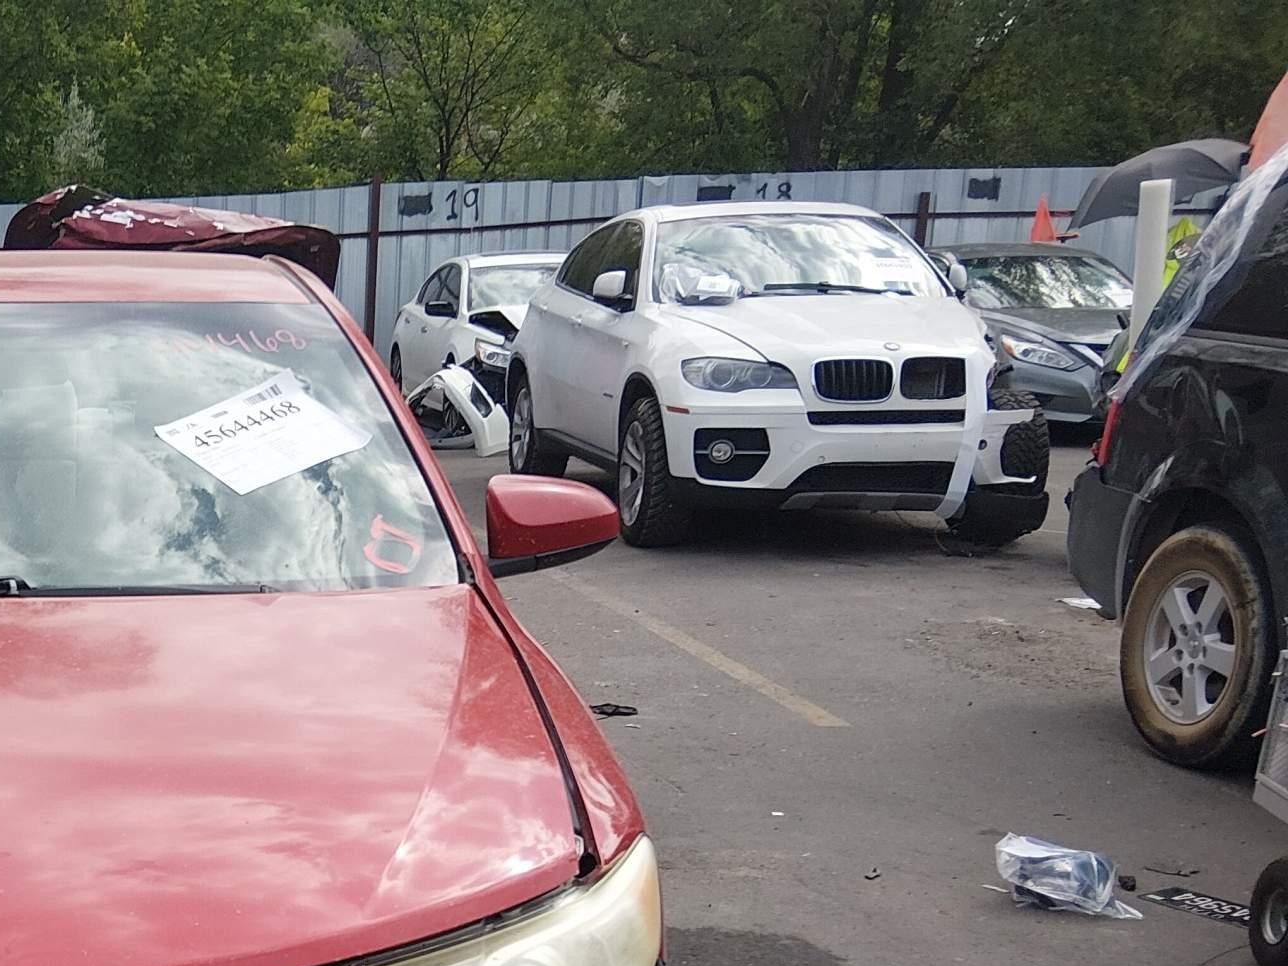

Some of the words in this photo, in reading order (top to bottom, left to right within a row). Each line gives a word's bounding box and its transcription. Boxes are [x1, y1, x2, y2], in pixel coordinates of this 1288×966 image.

[445, 188, 479, 222] 19
[756, 182, 792, 200] 18
[194, 400, 301, 448] 45644468
[1171, 892, 1251, 921] 45964
